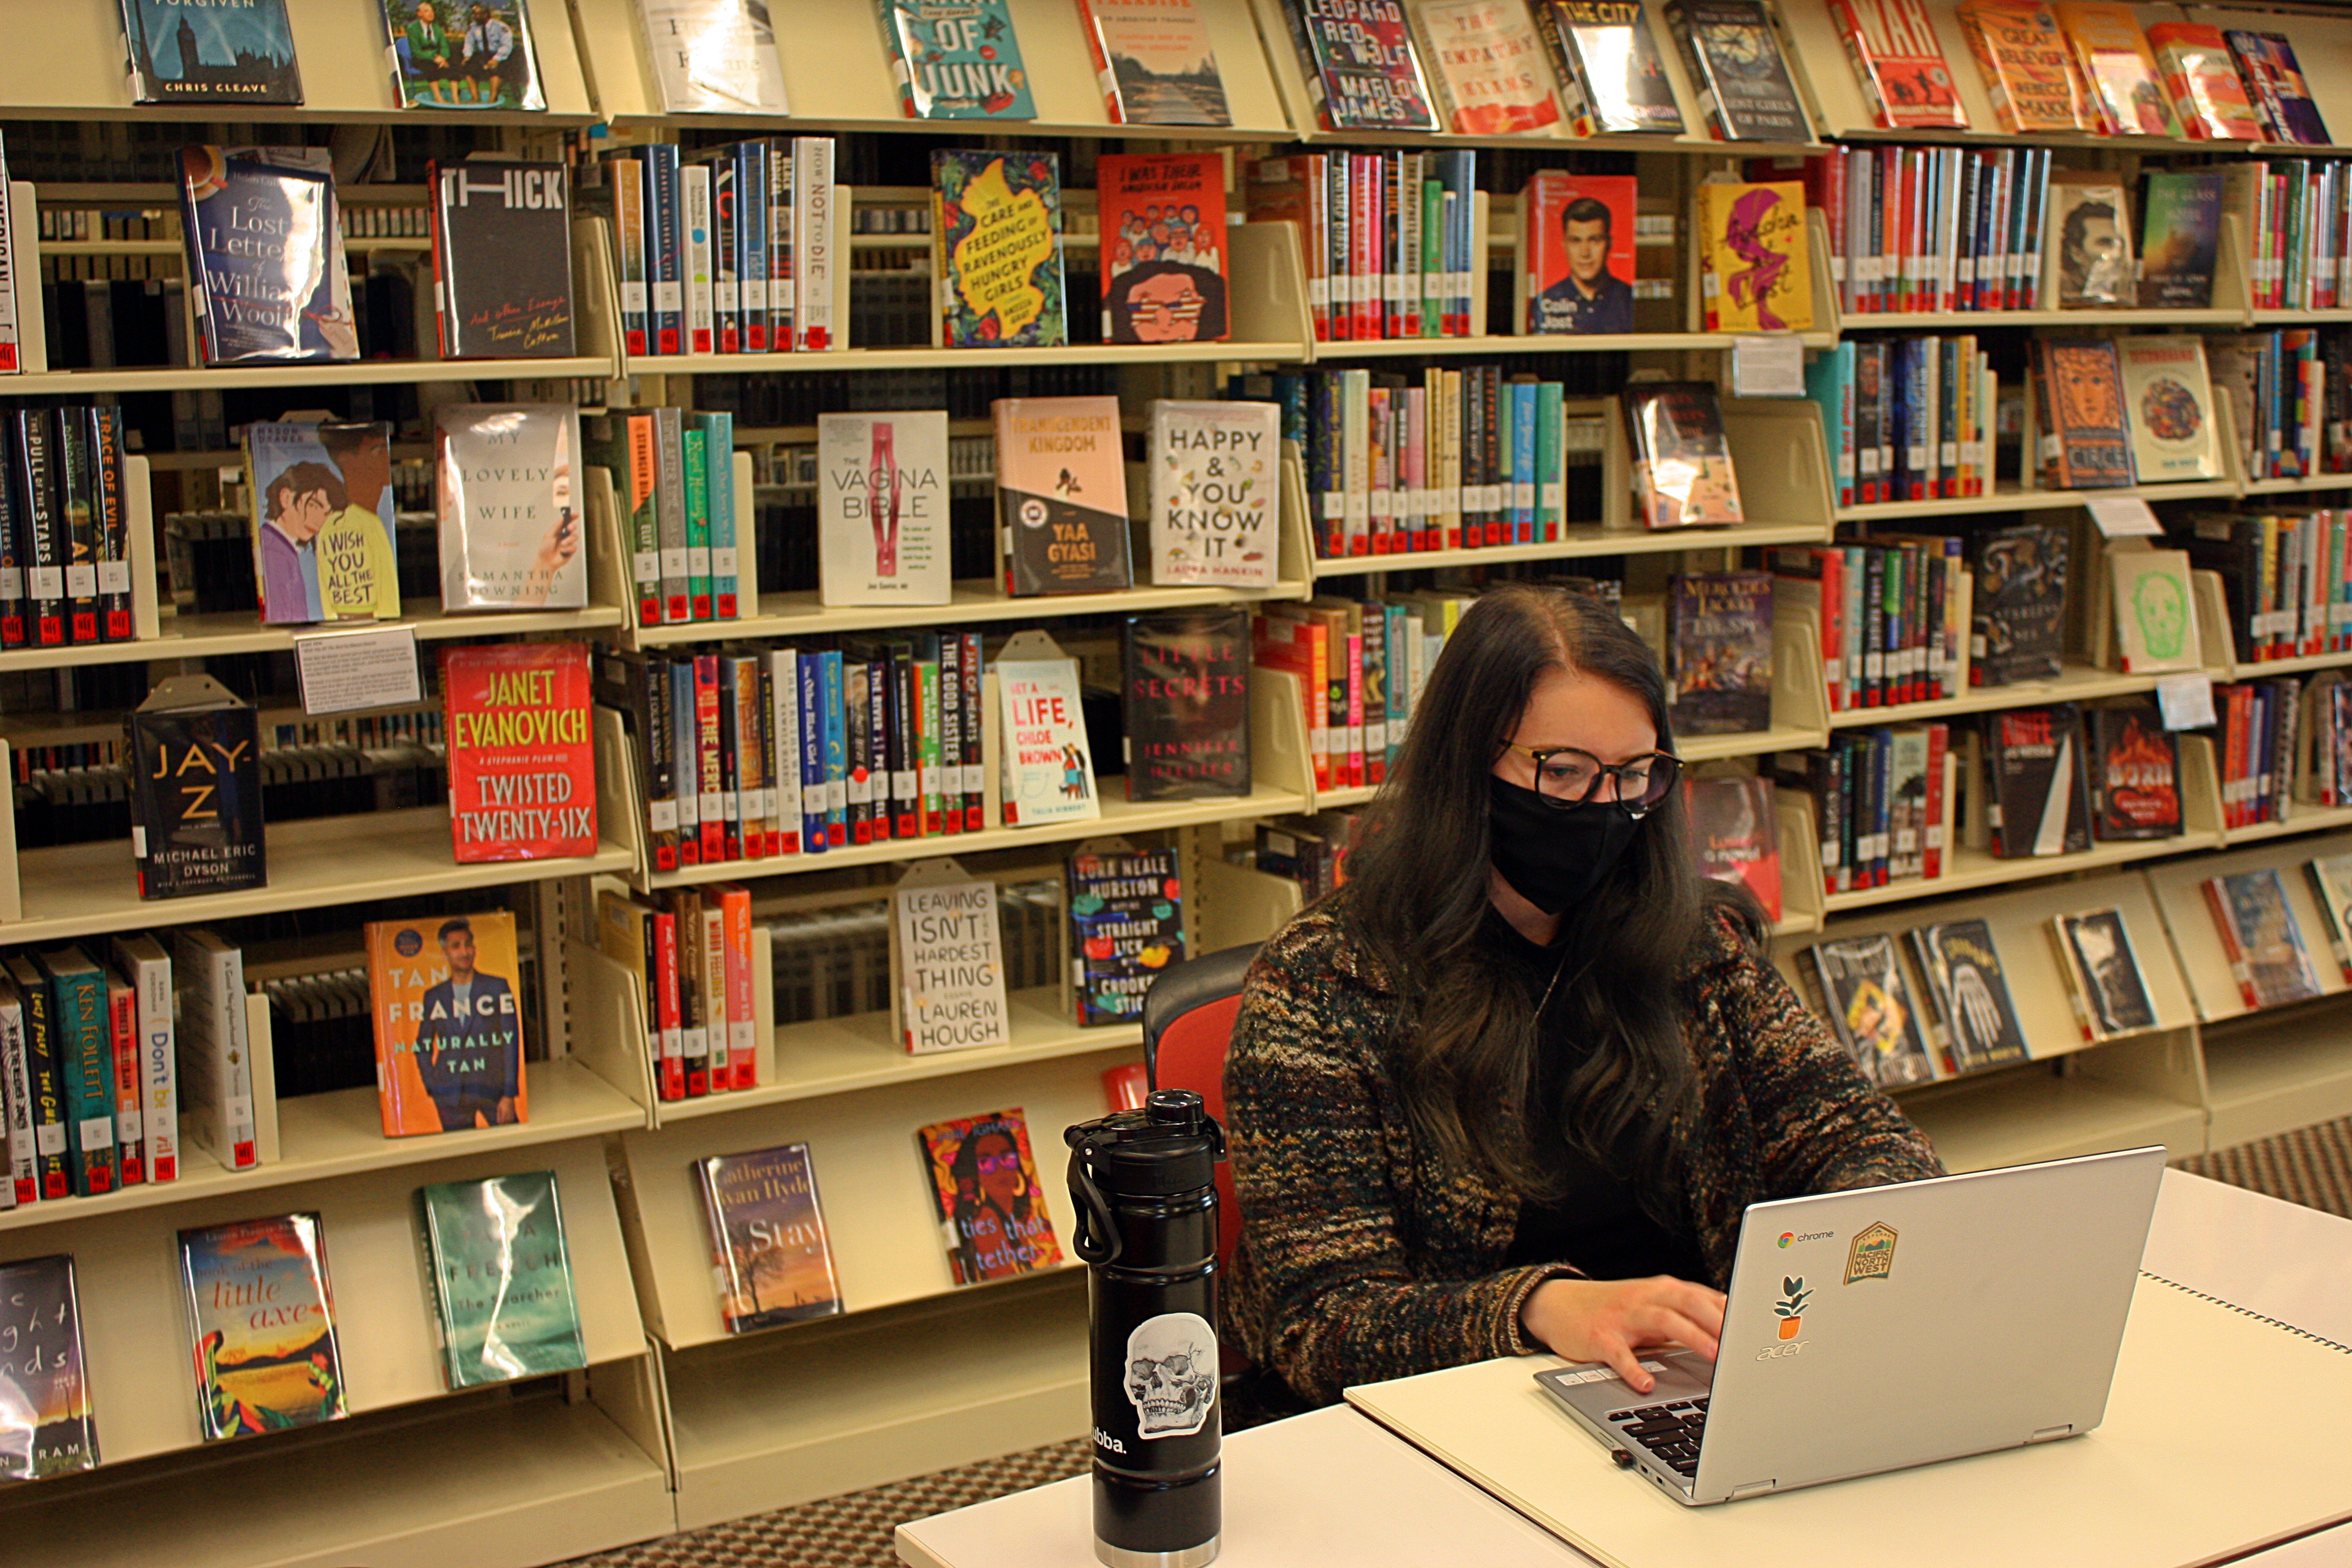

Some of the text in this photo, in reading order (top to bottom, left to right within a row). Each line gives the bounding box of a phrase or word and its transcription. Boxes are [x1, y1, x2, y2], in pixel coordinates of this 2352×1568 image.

[1456, 11, 1497, 33] THE
[1560, 2, 1643, 24] THE CITY
[935, 19, 979, 53] OF
[1852, 0, 1938, 56] WAR
[1351, 42, 1408, 66] WOLF
[1441, 35, 1535, 65] EMPATHY
[165, 83, 268, 94] CHRIS CLEAVE
[925, 63, 1014, 98] JUNK
[1338, 98, 1407, 121] JAMES
[814, 146, 824, 177] HOW
[812, 184, 825, 220] NOT
[232, 206, 290, 236] Lost
[981, 204, 1015, 228] CARE
[965, 221, 1025, 254] FEEDING
[812, 246, 825, 280] DIE
[962, 230, 1049, 274] RAVENOUSLY
[970, 259, 1027, 291] HUNGRY
[984, 276, 1023, 302] GIRLS
[1541, 298, 1577, 312] Colin
[1540, 315, 1575, 330] Jost
[1011, 415, 1113, 434] TRANSCENDENT
[487, 431, 522, 445] MY
[1028, 434, 1097, 453] KINGDOM
[1169, 429, 1264, 451] HAPPY
[843, 457, 861, 466] THE
[1207, 456, 1224, 477] &
[2068, 447, 2127, 470] CIRCE
[99, 413, 118, 532] TRACE OF EVIL
[462, 467, 549, 482] LOVELY
[831, 467, 939, 491] VAGINA
[29, 435, 51, 562] PULL STARS
[1187, 483, 1246, 505] YOU
[478, 505, 537, 520] WIFE
[842, 496, 929, 519] BIBLE
[1053, 522, 1090, 541] YAA
[1168, 510, 1264, 531] KNOW
[322, 531, 364, 556] I WISH
[1047, 543, 1096, 562] GYASI
[1205, 537, 1226, 557] IT
[328, 552, 364, 574] YOU
[329, 570, 374, 592] ALL THE
[332, 584, 375, 605] BEST
[1141, 643, 1235, 665] LITTLE
[485, 669, 556, 707] JANET
[1134, 675, 1246, 698] SECRETS
[942, 643, 960, 761] THE GOOD SISTER
[1011, 697, 1074, 729] LIFE,
[455, 709, 588, 749] EVANOVICH
[701, 713, 718, 745] THE
[804, 679, 818, 766] Other Black Girl
[966, 698, 977, 743] HEARTS
[1016, 731, 1053, 745] CHLOE
[1144, 739, 1238, 758] JENNIFER
[153, 740, 251, 779] JAY-
[1019, 749, 1064, 765] BROWN
[476, 772, 573, 807] TWISTED
[181, 785, 217, 820] Z
[460, 807, 592, 843] TWENTY-SIX
[154, 843, 257, 865] MICHAEL ERIC
[1121, 856, 1168, 875] NEALE
[184, 863, 230, 878] DYSON
[1090, 878, 1158, 897] HURSTON
[908, 888, 988, 913] LEAVING
[912, 914, 979, 944] ISN'T
[1097, 919, 1158, 937] STRAIGHT
[914, 943, 992, 963] HARDEST
[1114, 938, 1144, 955] LICK
[389, 966, 450, 989] TAN
[915, 966, 994, 992] THING
[117, 997, 129, 1035] CROOKED
[389, 993, 516, 1023] FRANCE
[919, 1000, 998, 1024] LAUREN
[75, 983, 104, 1100] KEN FOLLETT
[394, 1030, 515, 1054] NATURALLY
[921, 1021, 999, 1047] HOUGH
[151, 1032, 169, 1085] Don't
[446, 1059, 487, 1074] TAN
[749, 1218, 818, 1254] Stay
[961, 1212, 1047, 1240] ties that
[1796, 1231, 1834, 1243] chrome
[975, 1239, 1037, 1270] tether
[1855, 1249, 1890, 1261] PACIFIC
[1855, 1256, 1889, 1267] NORTH
[1853, 1262, 1887, 1275] WEST
[213, 1276, 281, 1310] little
[250, 1302, 309, 1331] axe
[1755, 1340, 1810, 1362] acer
[1091, 1426, 1127, 1455] ubba.
